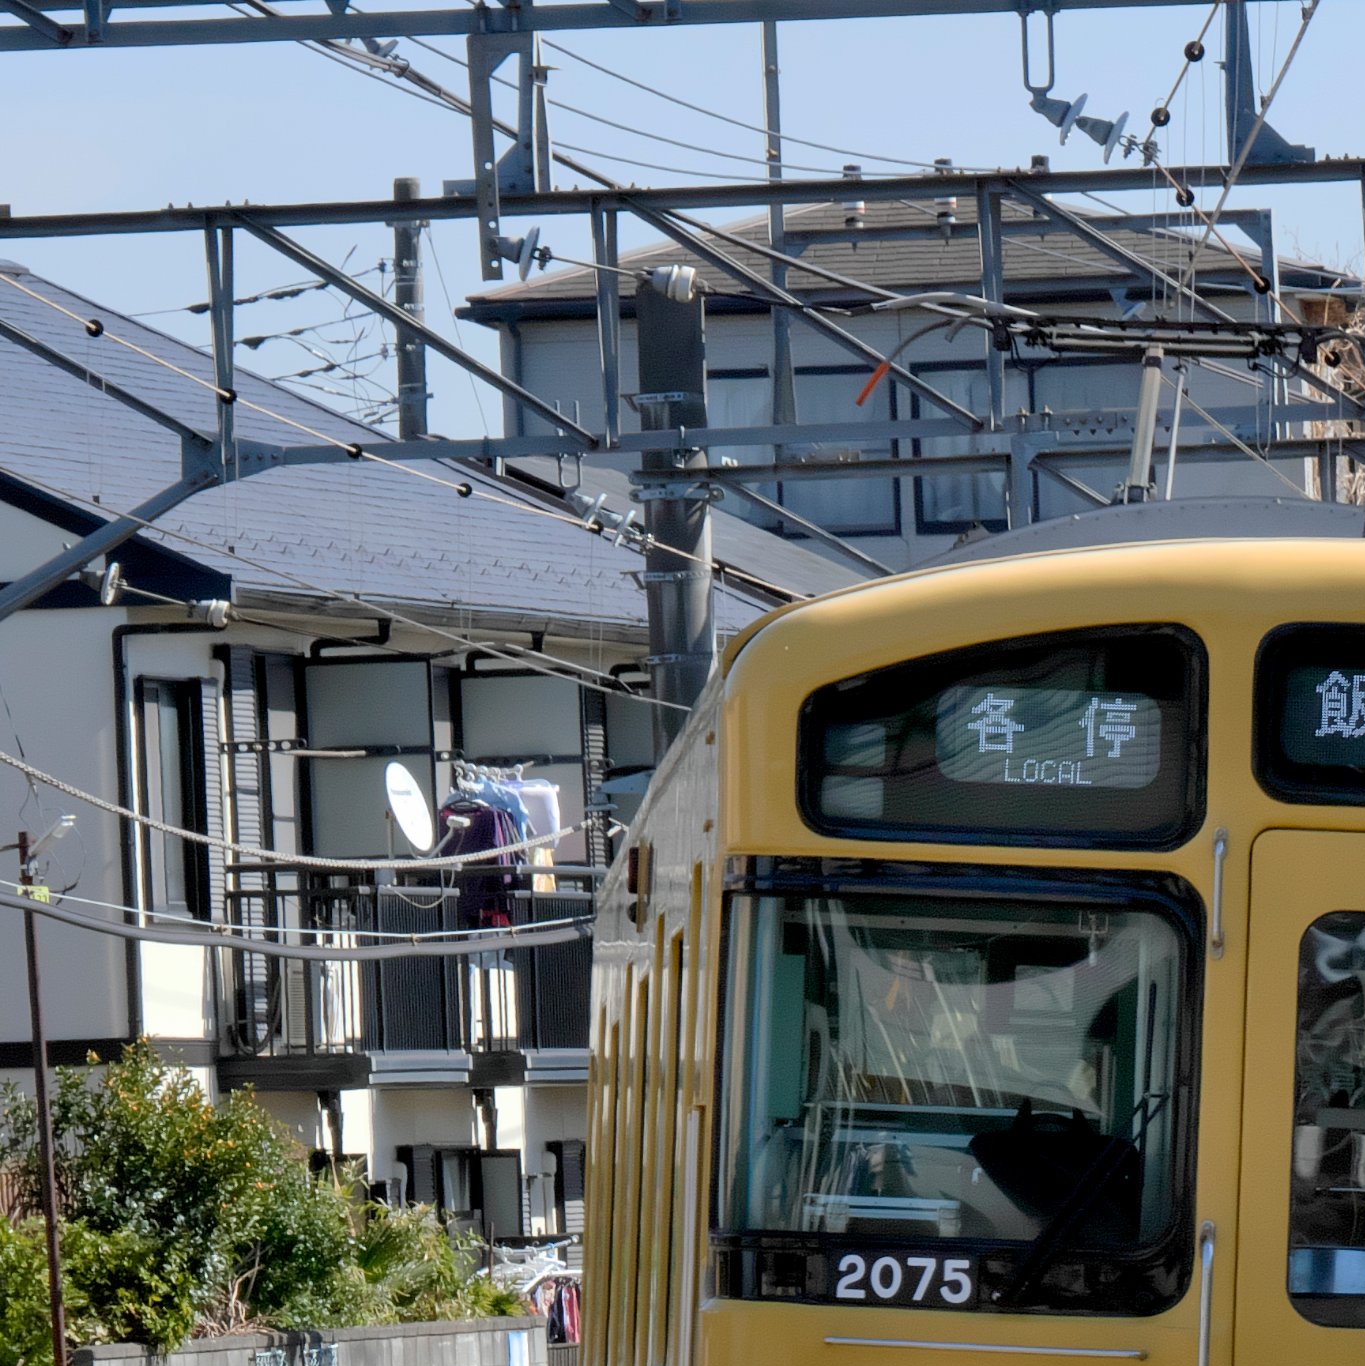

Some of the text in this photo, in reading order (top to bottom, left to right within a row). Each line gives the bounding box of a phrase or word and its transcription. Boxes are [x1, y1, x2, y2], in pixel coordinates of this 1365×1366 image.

[967, 693, 1136, 757] 各停
[1004, 758, 1092, 785] LOCAL
[836, 1254, 972, 1304] 2075
